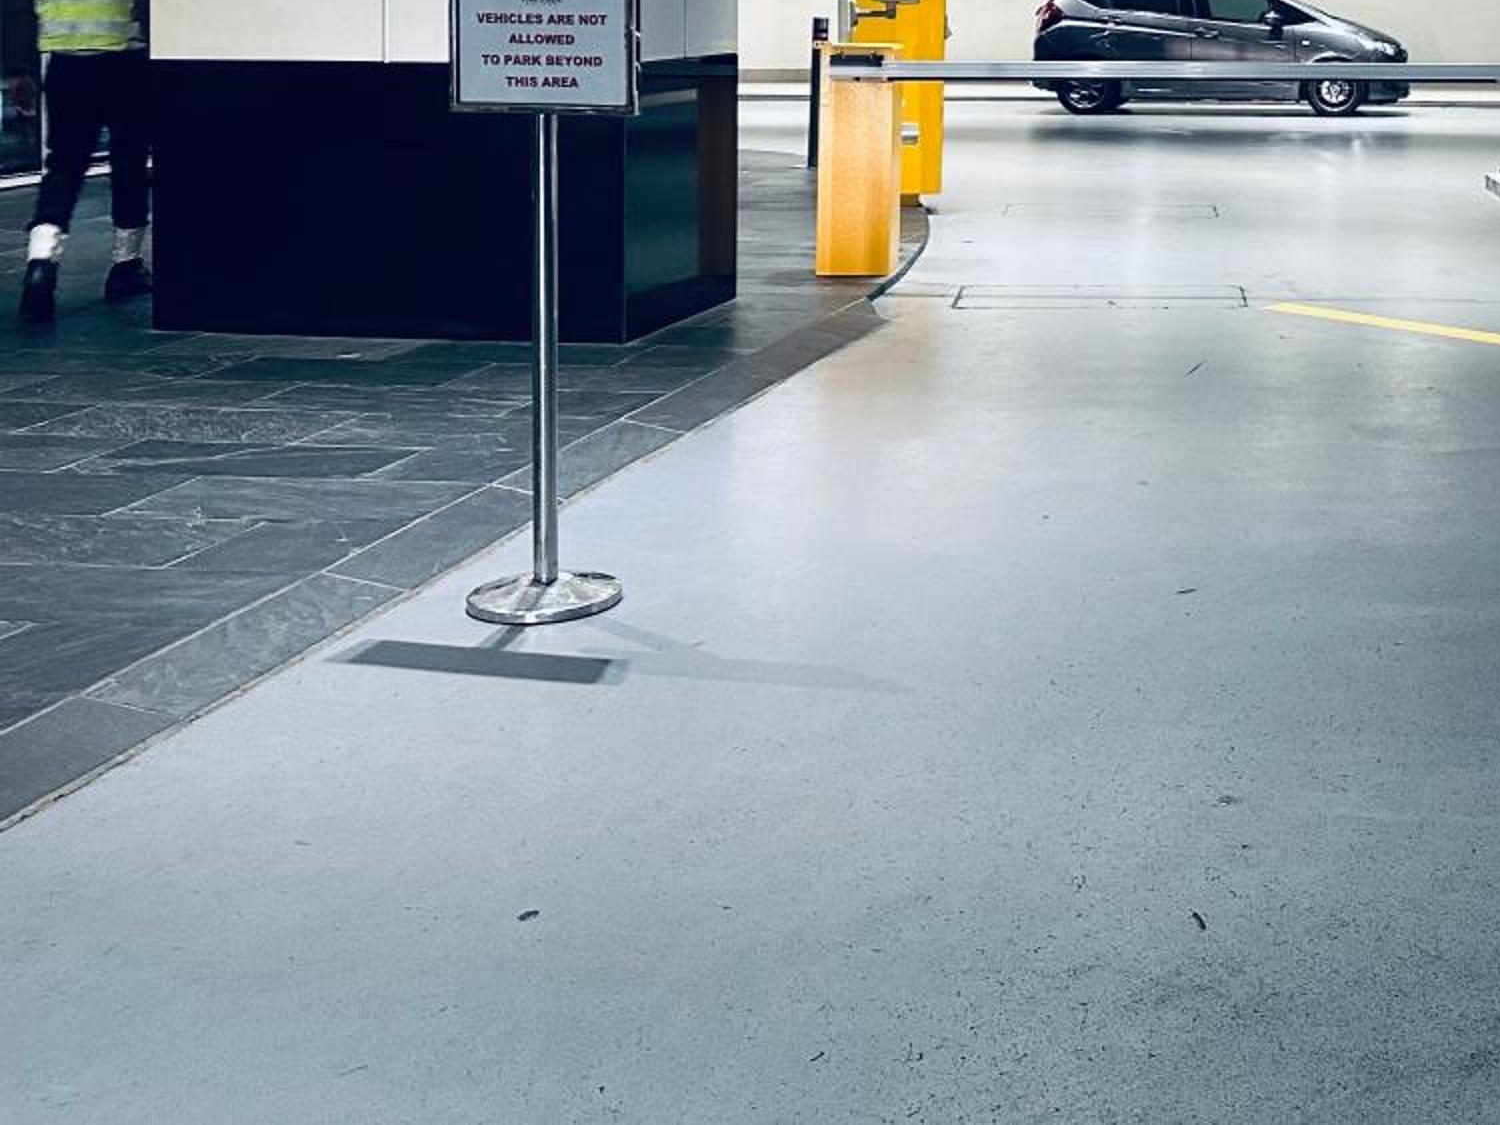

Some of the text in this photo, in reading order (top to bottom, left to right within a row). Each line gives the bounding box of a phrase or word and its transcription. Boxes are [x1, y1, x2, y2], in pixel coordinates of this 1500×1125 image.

[477, 13, 607, 25] VEHICLES ARE NOT
[509, 33, 575, 45] ALLOWED
[482, 54, 603, 67] TO PARK BEYOND
[506, 76, 579, 88] THIS AREA
